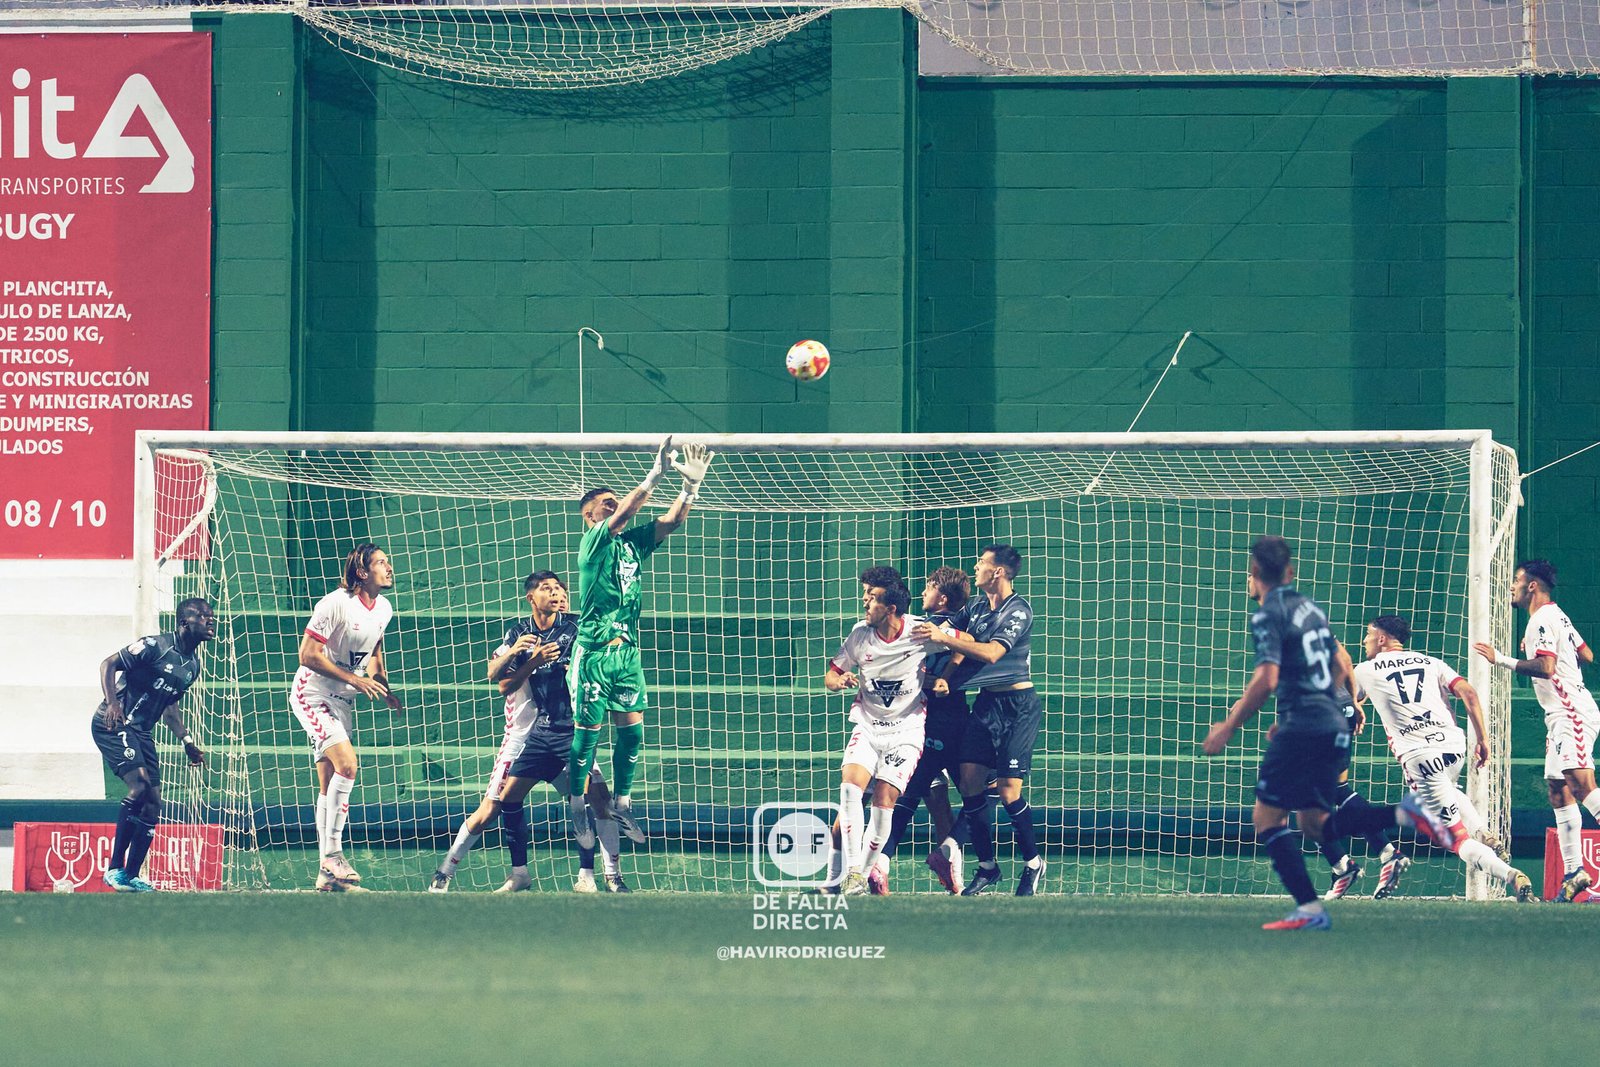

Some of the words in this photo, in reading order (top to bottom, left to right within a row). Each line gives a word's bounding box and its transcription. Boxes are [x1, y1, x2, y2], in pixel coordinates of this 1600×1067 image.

[4, 281, 113, 299] PLANCHITA,
[38, 304, 62, 319] DE
[68, 304, 132, 322] LANZA,
[23, 326, 67, 342] 2500
[73, 327, 104, 345] KG,
[0, 349, 74, 366] TRICOS,
[2, 367, 149, 387] CONSTRUCCIÓN
[12, 394, 24, 409] Y
[30, 394, 193, 409] MINIGIRATORIAS
[0, 417, 94, 435] DUMPERS,
[0, 440, 63, 454] LADOS
[4, 500, 41, 527] 08
[49, 499, 62, 528] /
[71, 500, 107, 527] 10
[1374, 657, 1431, 671] MARCOS
[1386, 668, 1425, 704] 17
[118, 731, 128, 748] 7
[168, 838, 203, 872] REY
